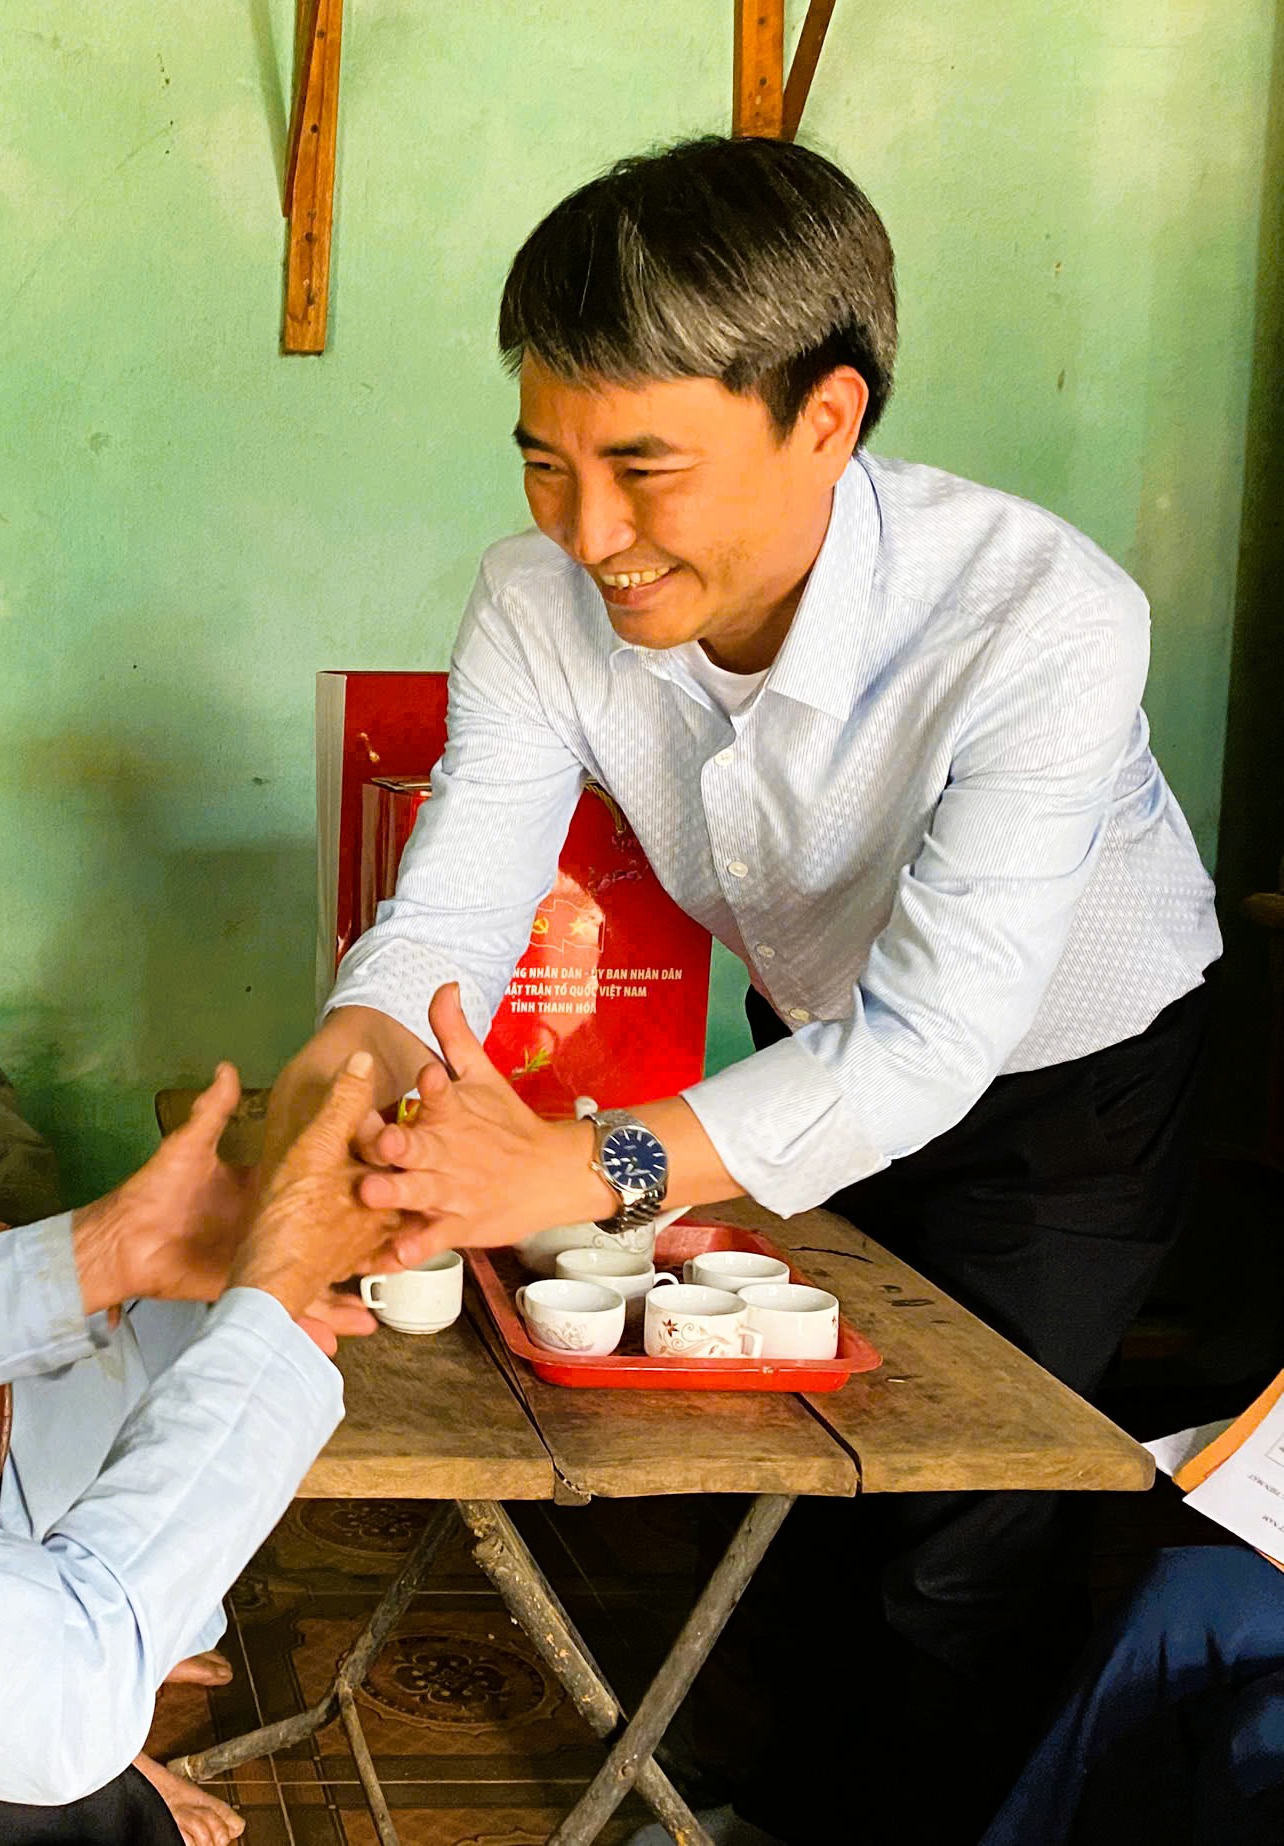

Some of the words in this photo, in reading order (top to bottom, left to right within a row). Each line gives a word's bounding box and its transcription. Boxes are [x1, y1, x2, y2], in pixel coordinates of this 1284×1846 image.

[512, 967, 527, 979] NG
[529, 965, 559, 979] NHÂN
[561, 966, 582, 979] DÂN
[606, 968, 628, 980] BAN
[630, 967, 659, 980] NHÂN
[661, 967, 683, 980] DÂN
[525, 982, 552, 999] TRẬN
[569, 981, 597, 998] QUỐC
[599, 984, 622, 999] VIỆT
[623, 986, 647, 997] NAM
[510, 998, 535, 1013] TỈNH
[537, 1001, 573, 1013] THANH
